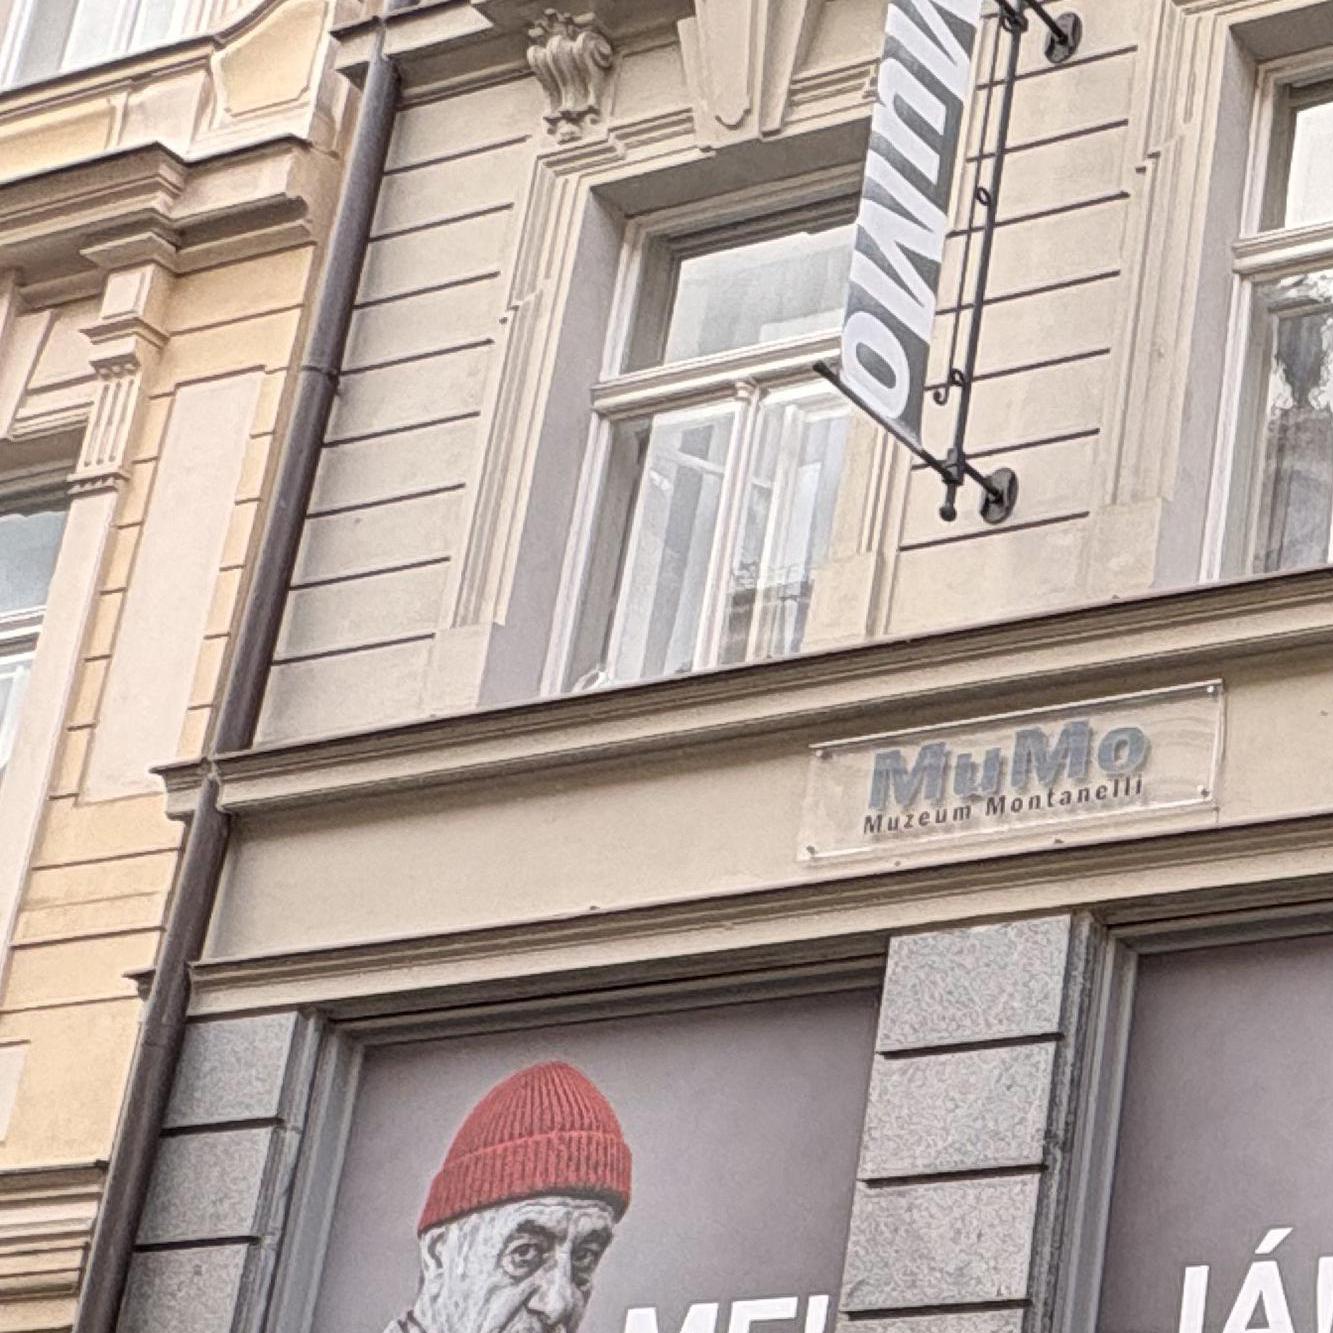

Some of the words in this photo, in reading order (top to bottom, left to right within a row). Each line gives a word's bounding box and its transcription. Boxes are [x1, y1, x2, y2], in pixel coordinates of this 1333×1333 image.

[868, 718, 1150, 812] MuMo
[863, 803, 972, 835] Muzeum
[984, 775, 1144, 818] Montanelli
